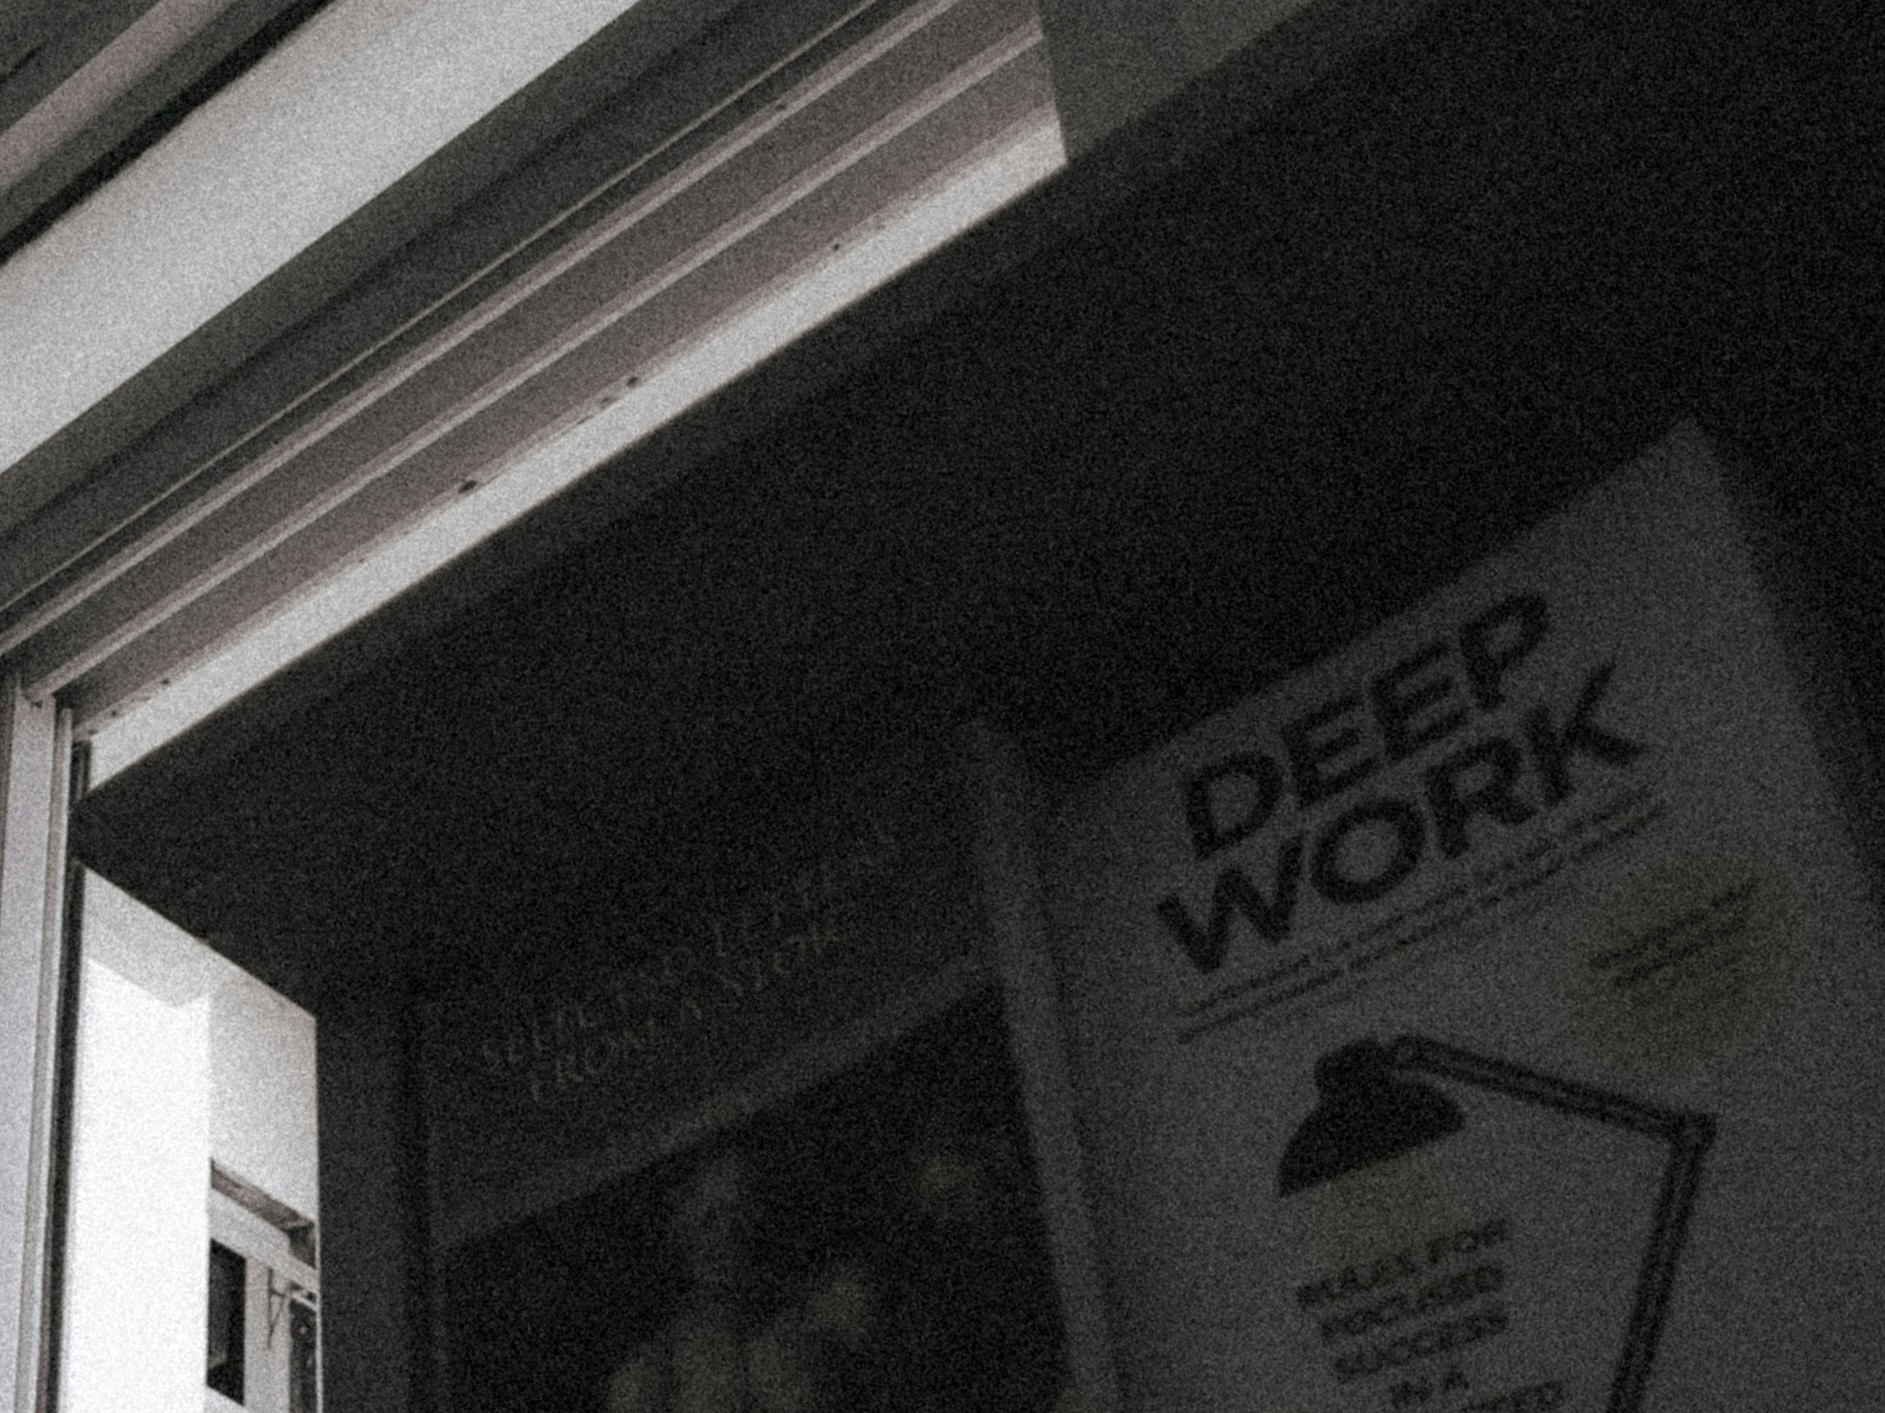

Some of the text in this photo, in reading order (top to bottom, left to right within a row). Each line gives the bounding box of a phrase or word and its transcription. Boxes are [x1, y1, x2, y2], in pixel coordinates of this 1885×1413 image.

[1181, 591, 1552, 861] DEEP
[1155, 660, 1647, 975] WORK
[1294, 1217, 1512, 1310] RULES FOR
[1318, 1264, 1506, 1344] FOCUSED
[1332, 1307, 1510, 1384] SUCCESS
[1387, 1364, 1471, 1411] IN A
